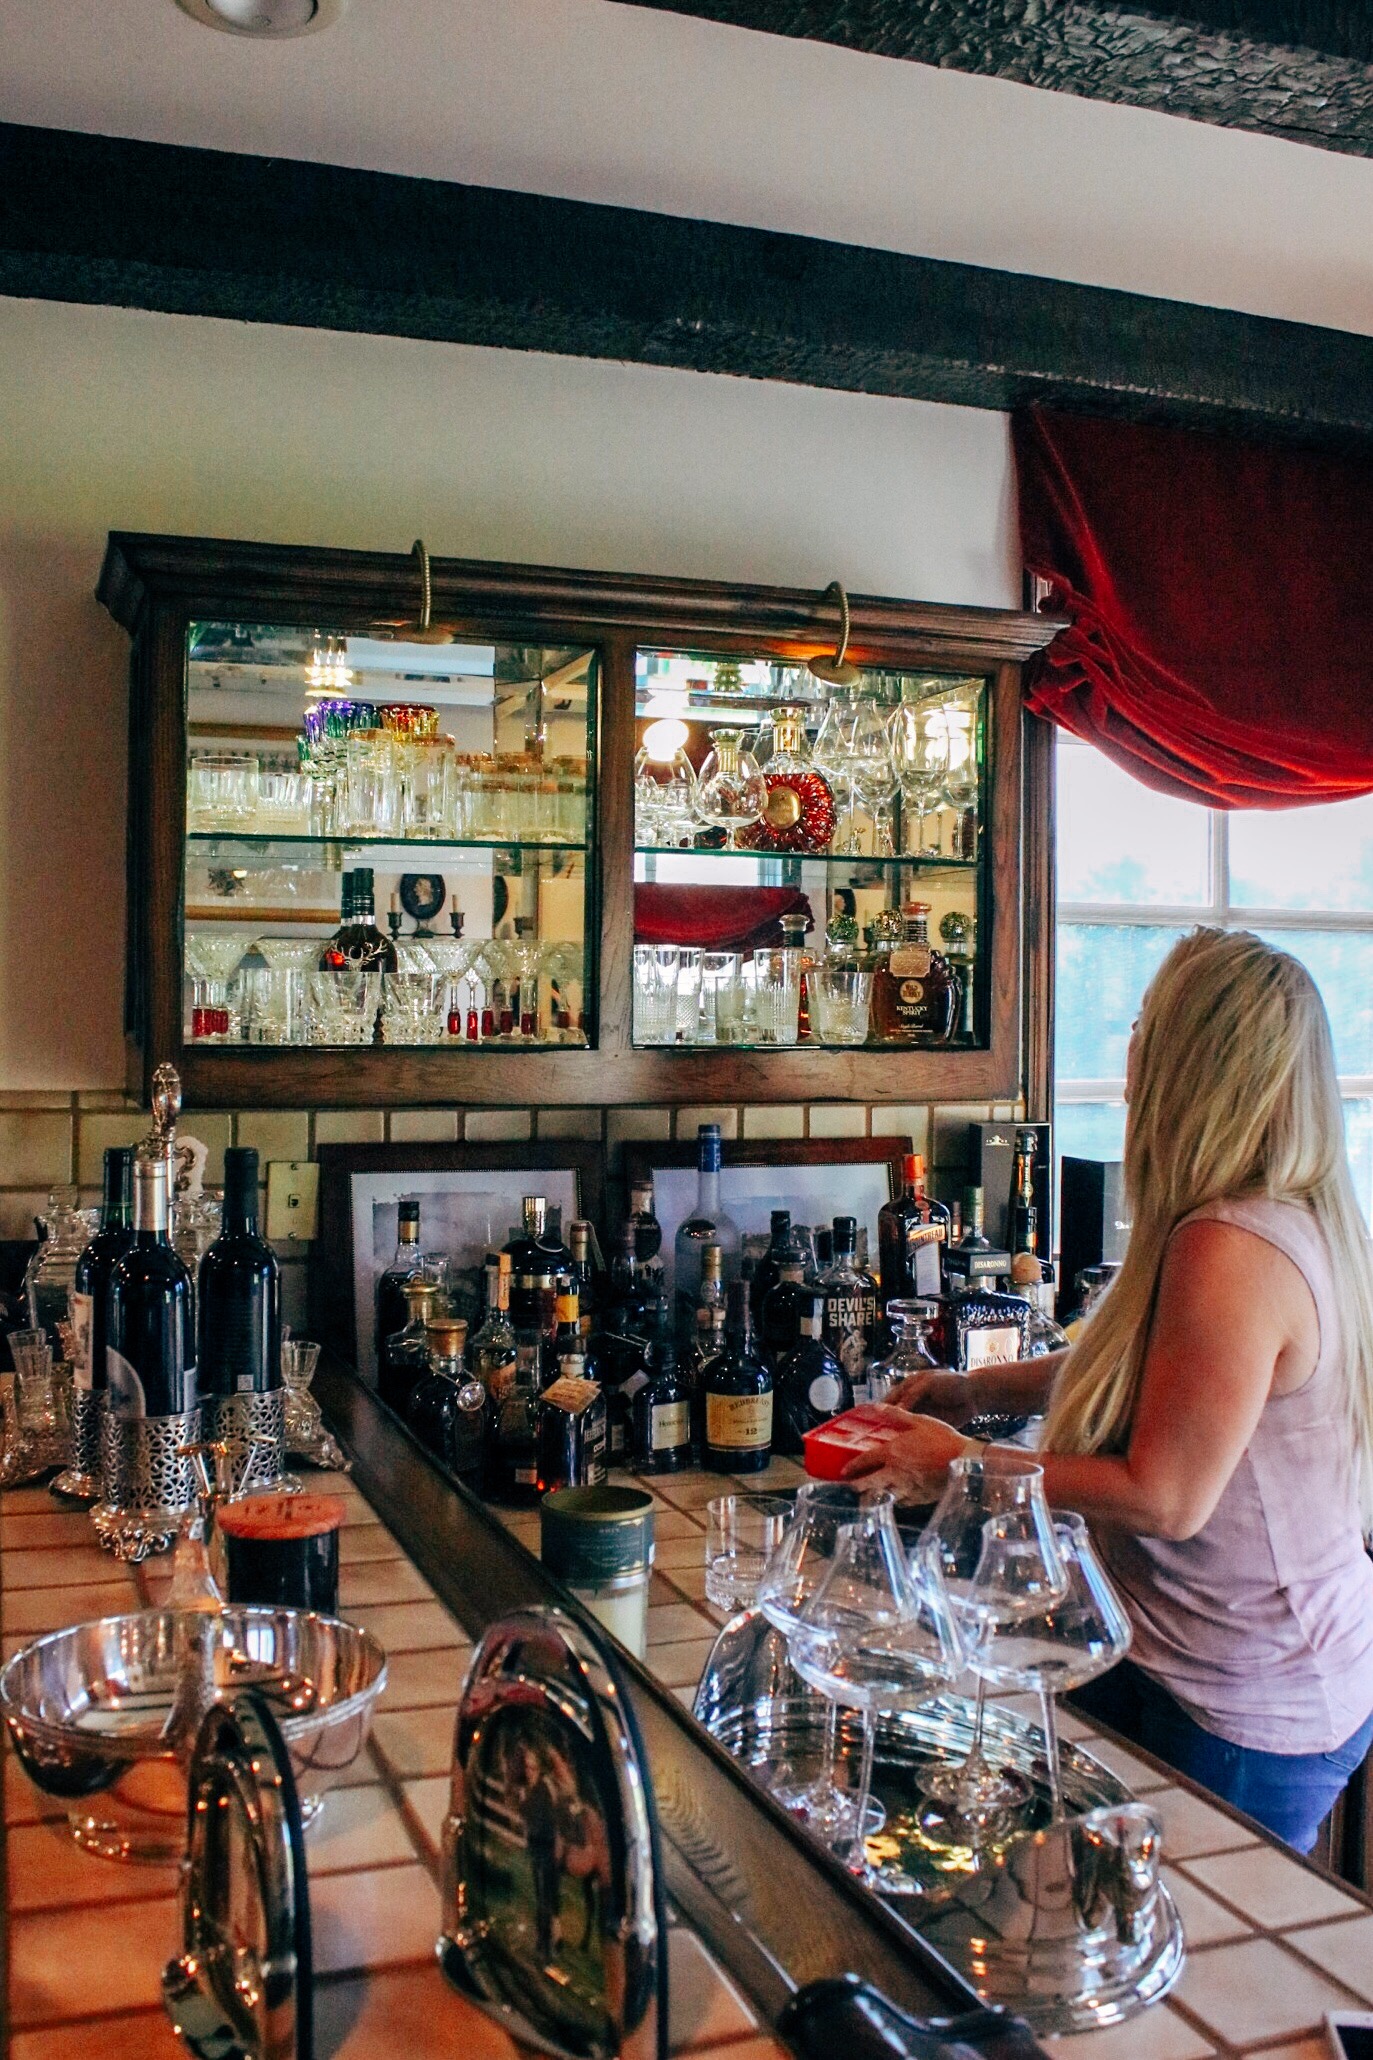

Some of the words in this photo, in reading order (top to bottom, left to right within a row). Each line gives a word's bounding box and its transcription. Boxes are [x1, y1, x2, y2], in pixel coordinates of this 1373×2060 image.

[974, 1260, 1007, 1269] DISARONNO
[827, 1296, 874, 1312] DEVIL'S
[829, 1311, 873, 1327] SHARE
[970, 1355, 1014, 1368] DISARONNO
[745, 1427, 758, 1435] 12
